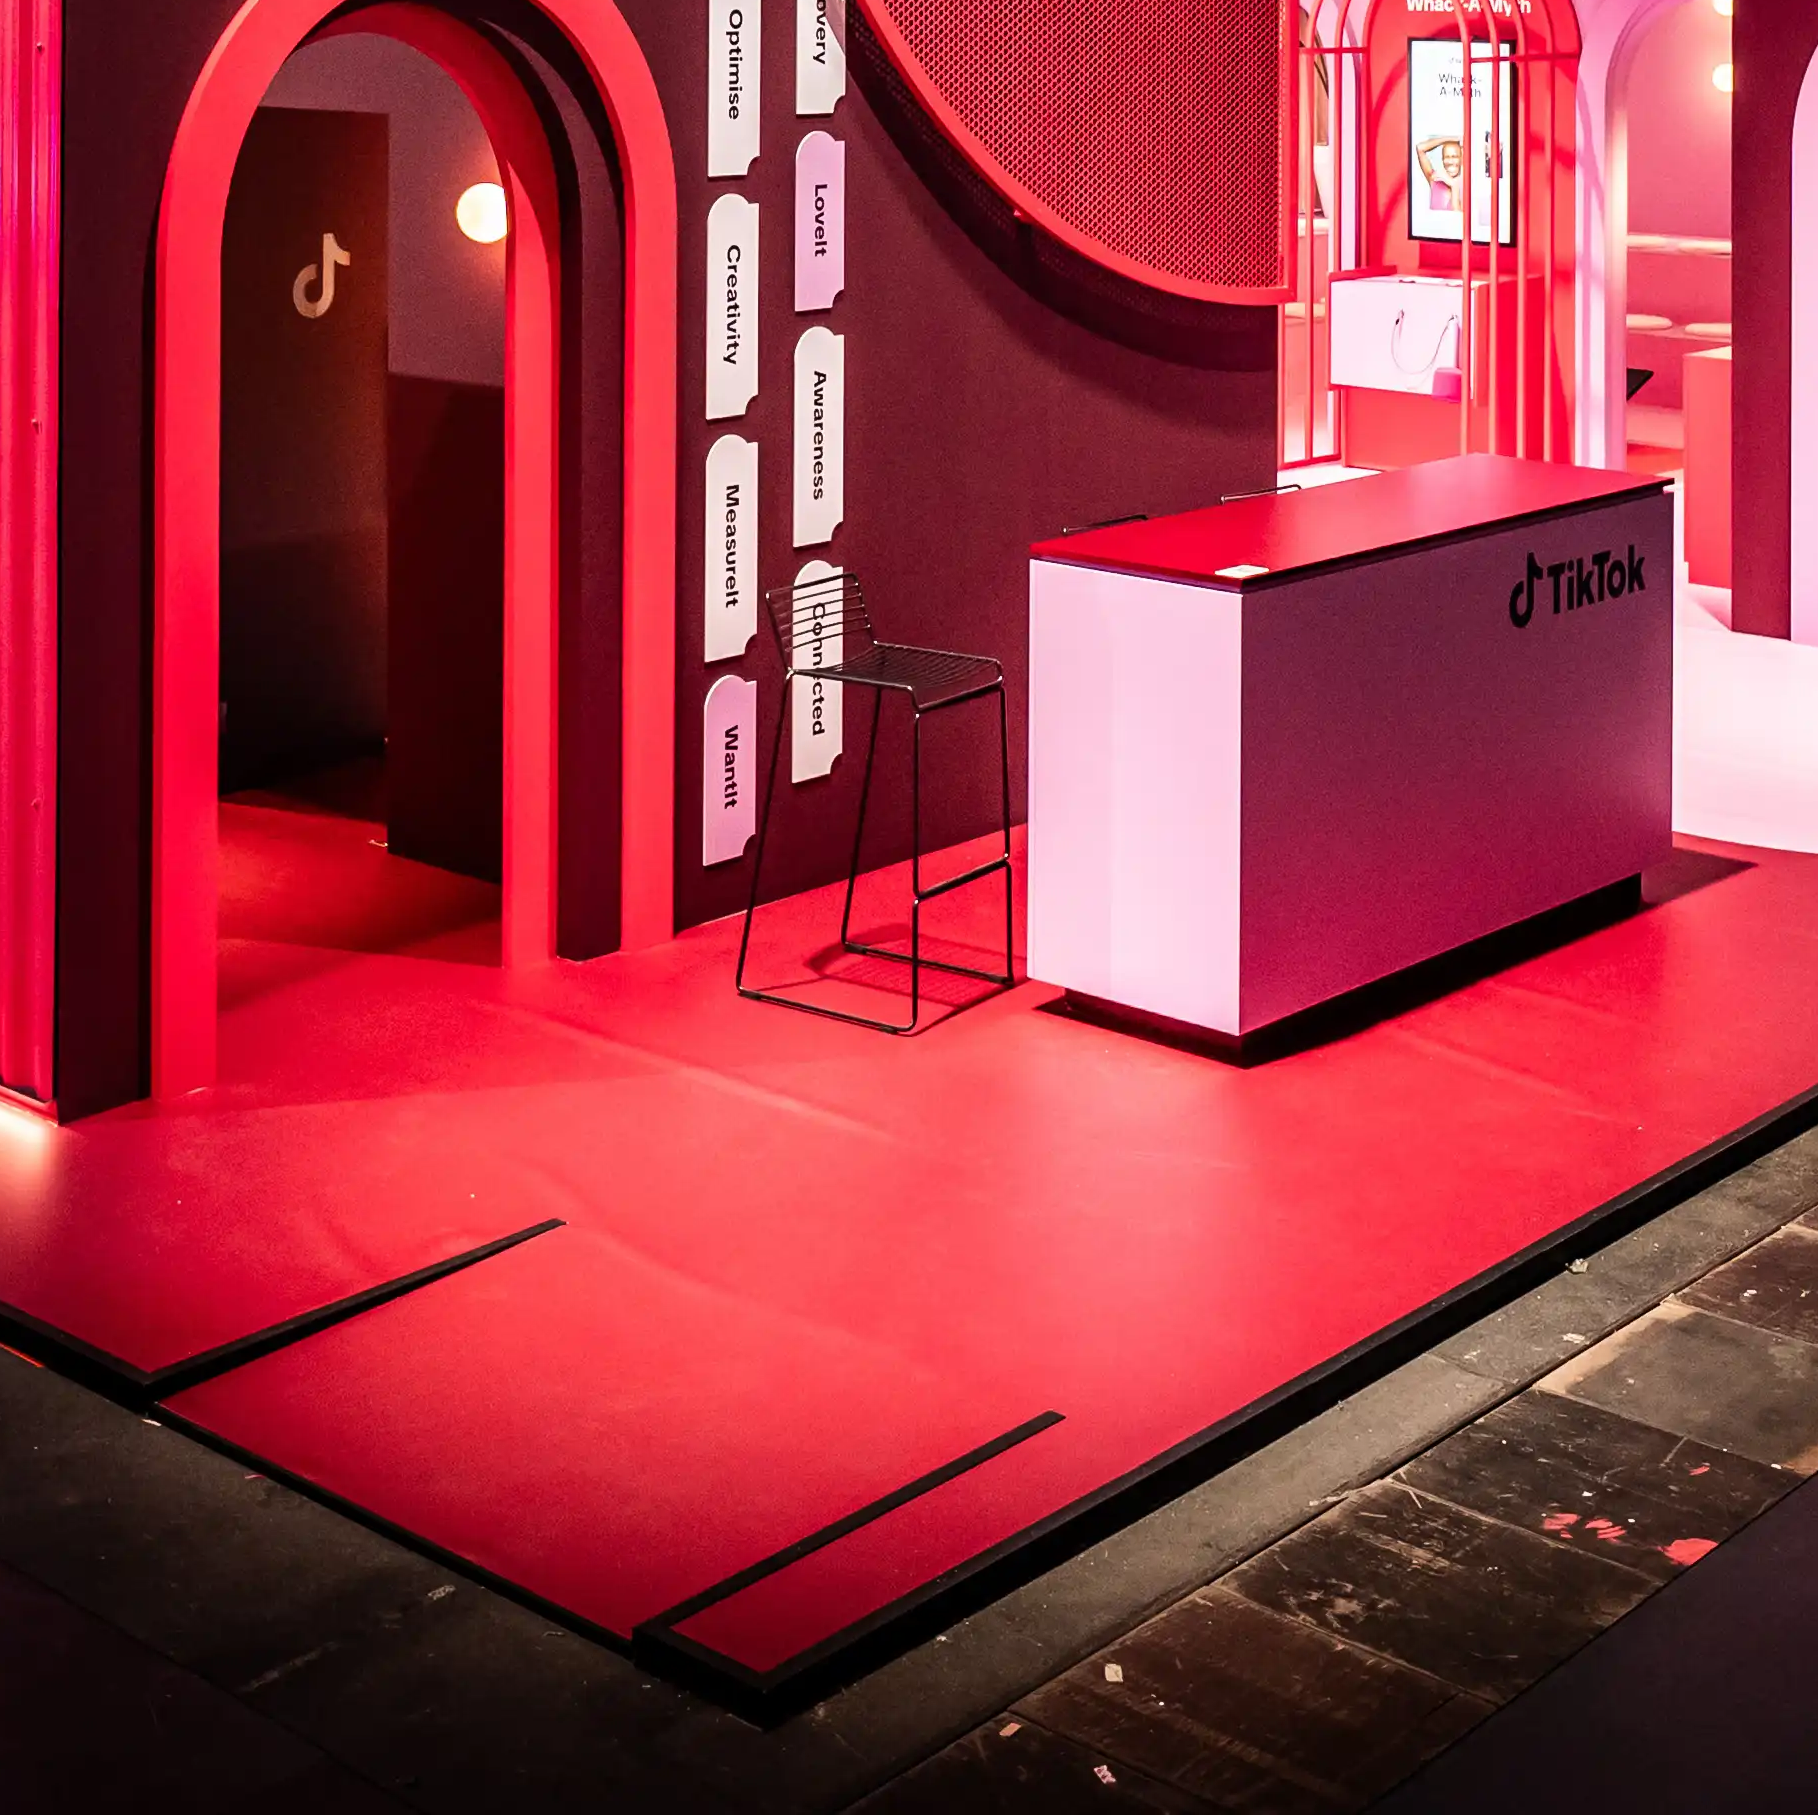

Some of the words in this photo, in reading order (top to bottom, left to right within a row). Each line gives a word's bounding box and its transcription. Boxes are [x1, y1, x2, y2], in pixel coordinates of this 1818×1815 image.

[726, 8, 743, 120] Optimise
[722, 244, 741, 365] Creativity
[812, 370, 827, 500] Awareness
[1547, 544, 1646, 615] TikTok
[812, 602, 826, 736] Conncted
